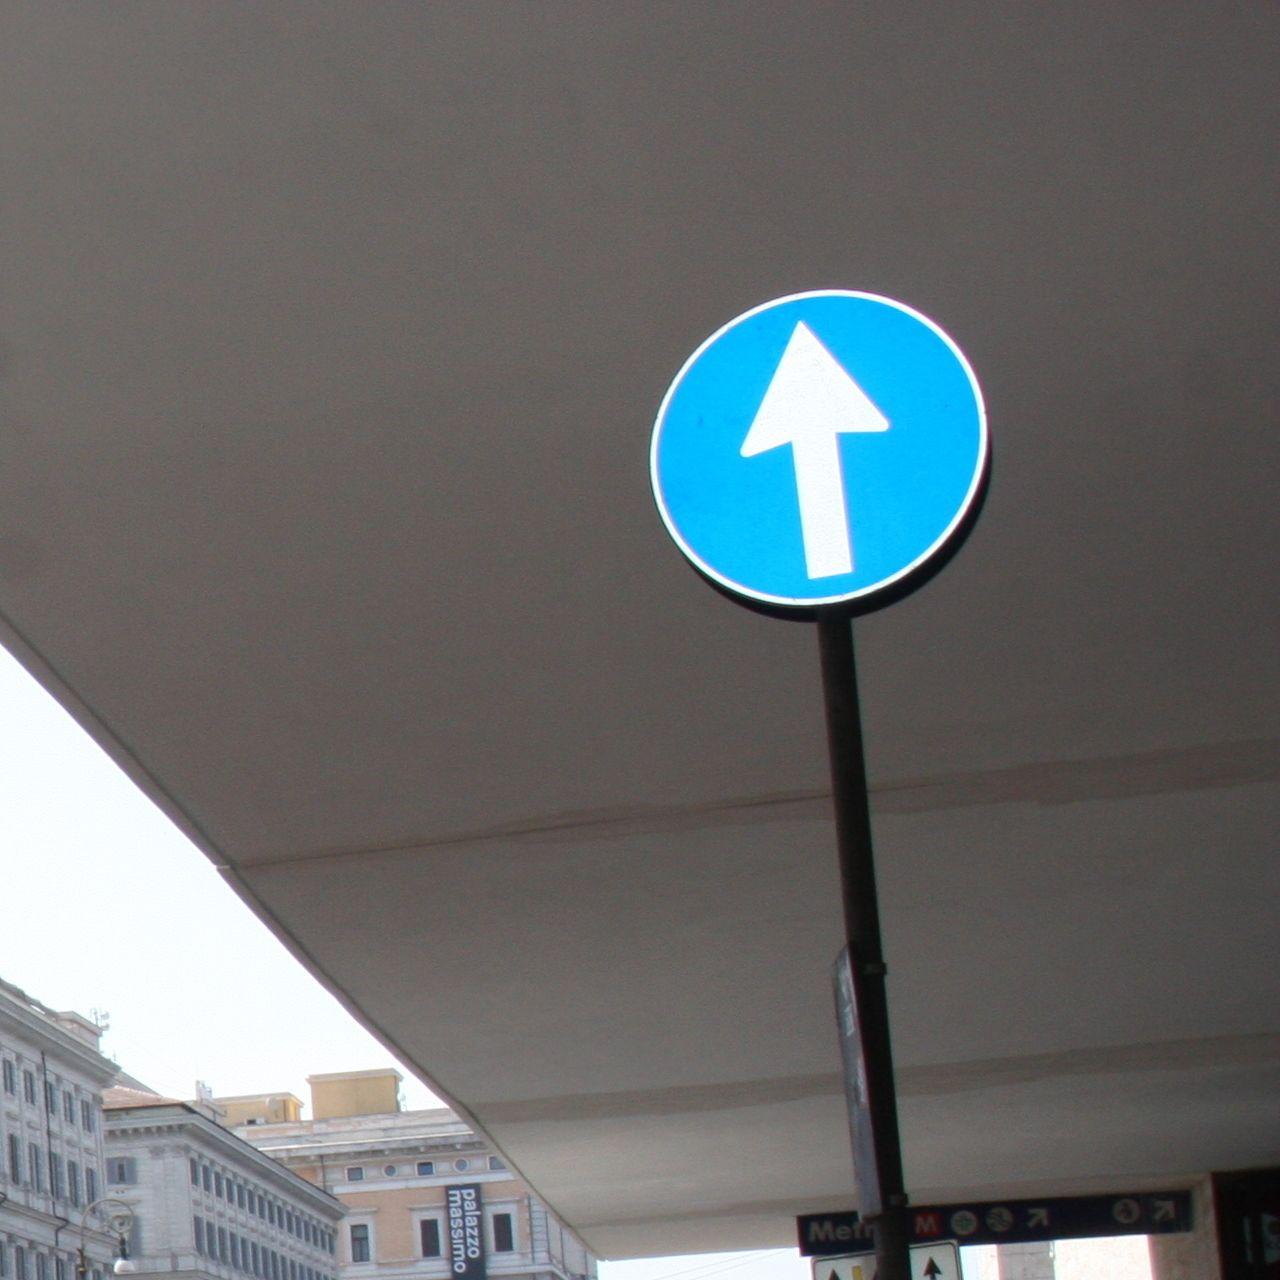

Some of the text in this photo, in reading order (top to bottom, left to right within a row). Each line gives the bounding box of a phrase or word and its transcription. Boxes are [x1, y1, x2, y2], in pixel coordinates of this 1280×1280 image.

[448, 1189, 467, 1274] massimo
[461, 1188, 481, 1260] palazzo
[808, 1219, 878, 1243] Metr
